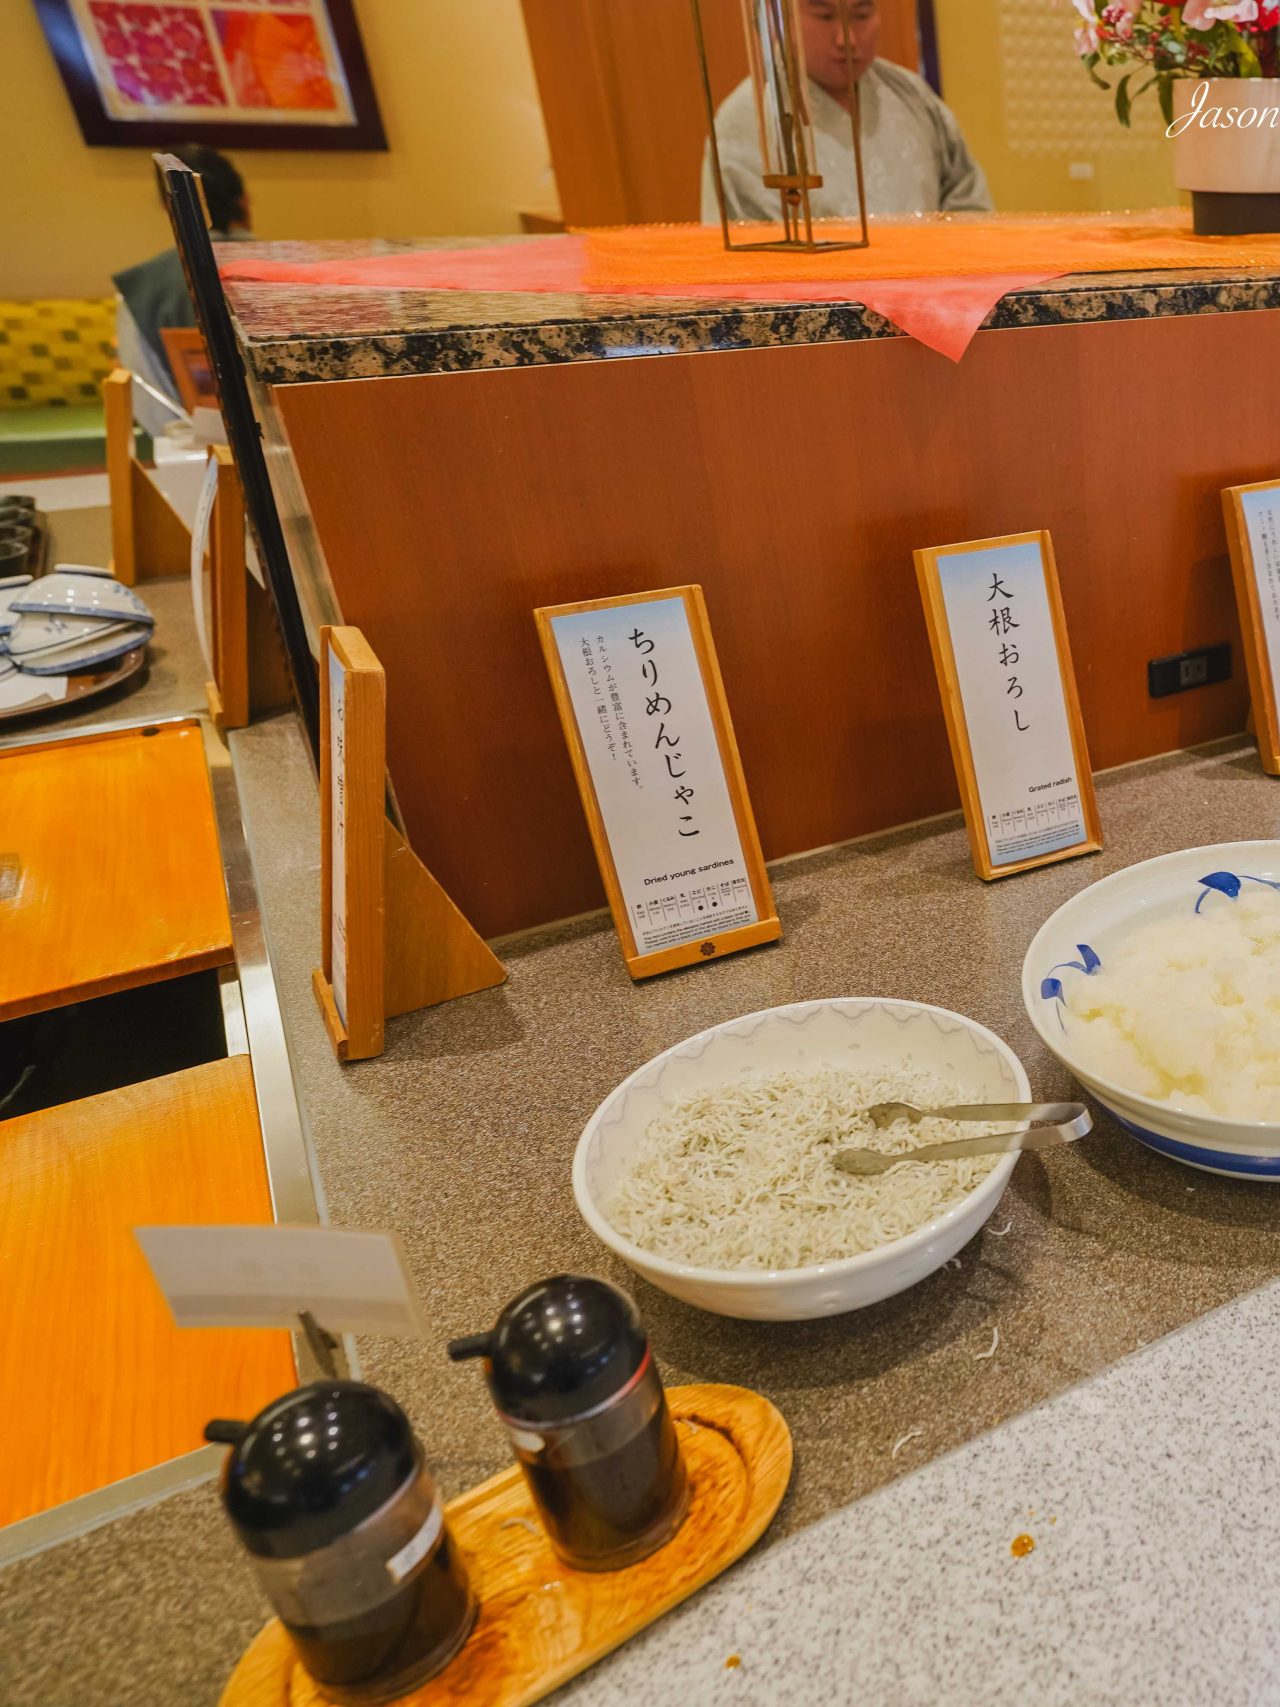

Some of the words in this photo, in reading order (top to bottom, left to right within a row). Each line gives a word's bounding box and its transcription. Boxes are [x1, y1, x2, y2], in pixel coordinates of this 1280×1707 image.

[986, 572, 1031, 732] 大根おろし
[627, 627, 701, 838] ちりめんじゃこ
[1028, 782, 1052, 793] Grated
[1052, 776, 1073, 787] radish
[643, 874, 669, 886] Dried
[669, 868, 697, 880] young
[698, 858, 735, 872] sardines
